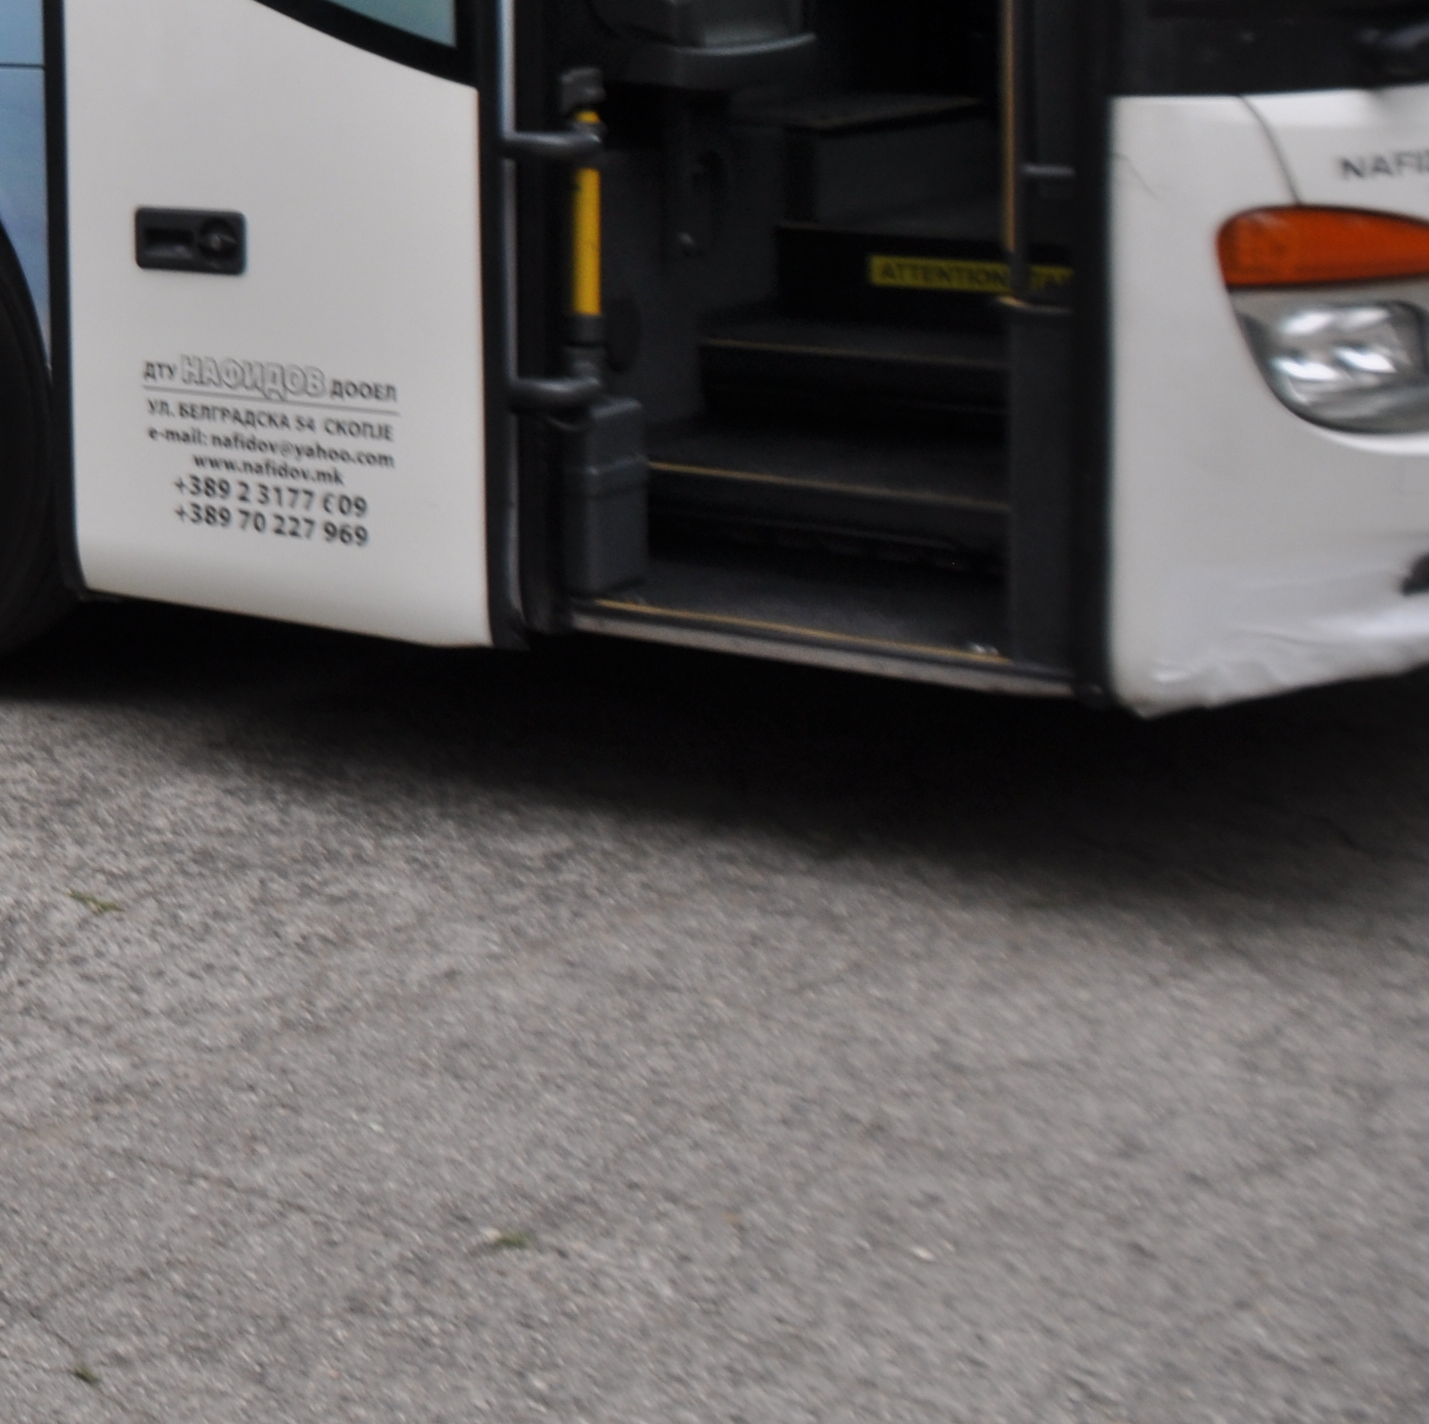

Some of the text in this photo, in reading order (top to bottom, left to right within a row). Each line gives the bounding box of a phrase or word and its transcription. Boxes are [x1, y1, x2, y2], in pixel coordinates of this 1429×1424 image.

[1341, 148, 1429, 181] NAFI
[144, 354, 398, 403] ДТУ НАФИДОВ ДООЕЛ
[178, 401, 291, 431] БЕЛГРАДСКА
[147, 426, 396, 468] e-mail: nafidov@yahoo.com
[193, 454, 345, 486] www.nafidov.mk
[174, 474, 230, 499] +389
[237, 479, 253, 503] 2
[256, 483, 315, 511] 3177
[174, 502, 369, 547] +389 70 227 969
